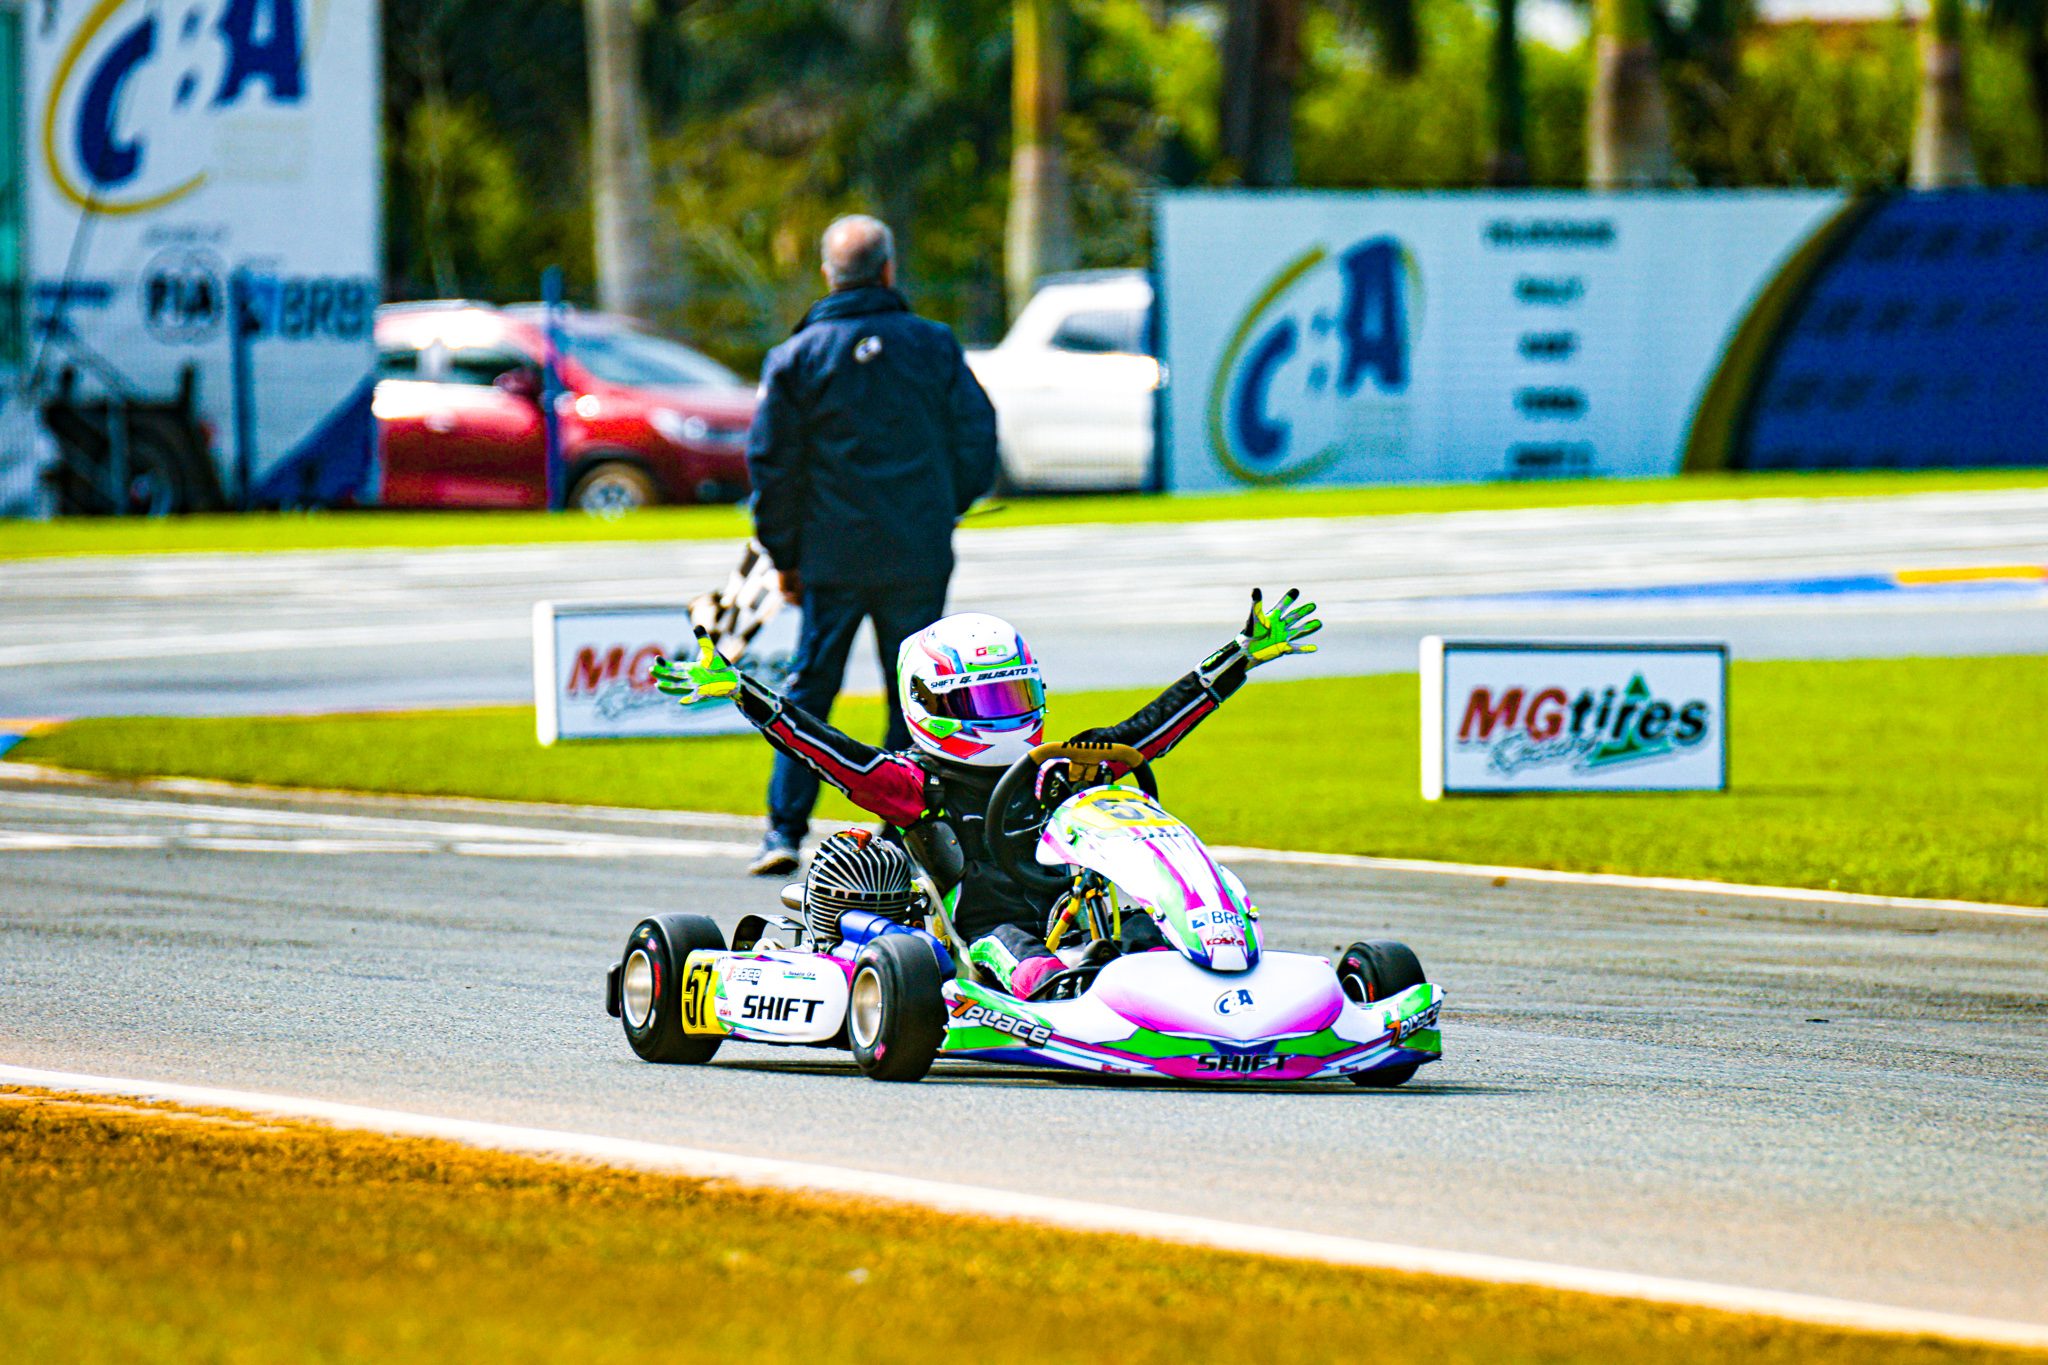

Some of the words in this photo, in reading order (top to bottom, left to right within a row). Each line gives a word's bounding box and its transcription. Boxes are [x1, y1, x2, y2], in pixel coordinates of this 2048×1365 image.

[977, 667, 1028, 681] BUSATO
[1456, 684, 1709, 746] MGtires
[683, 961, 713, 1029] 57
[741, 994, 825, 1023] SHIFT
[1195, 1053, 1293, 1073] SHIFT
